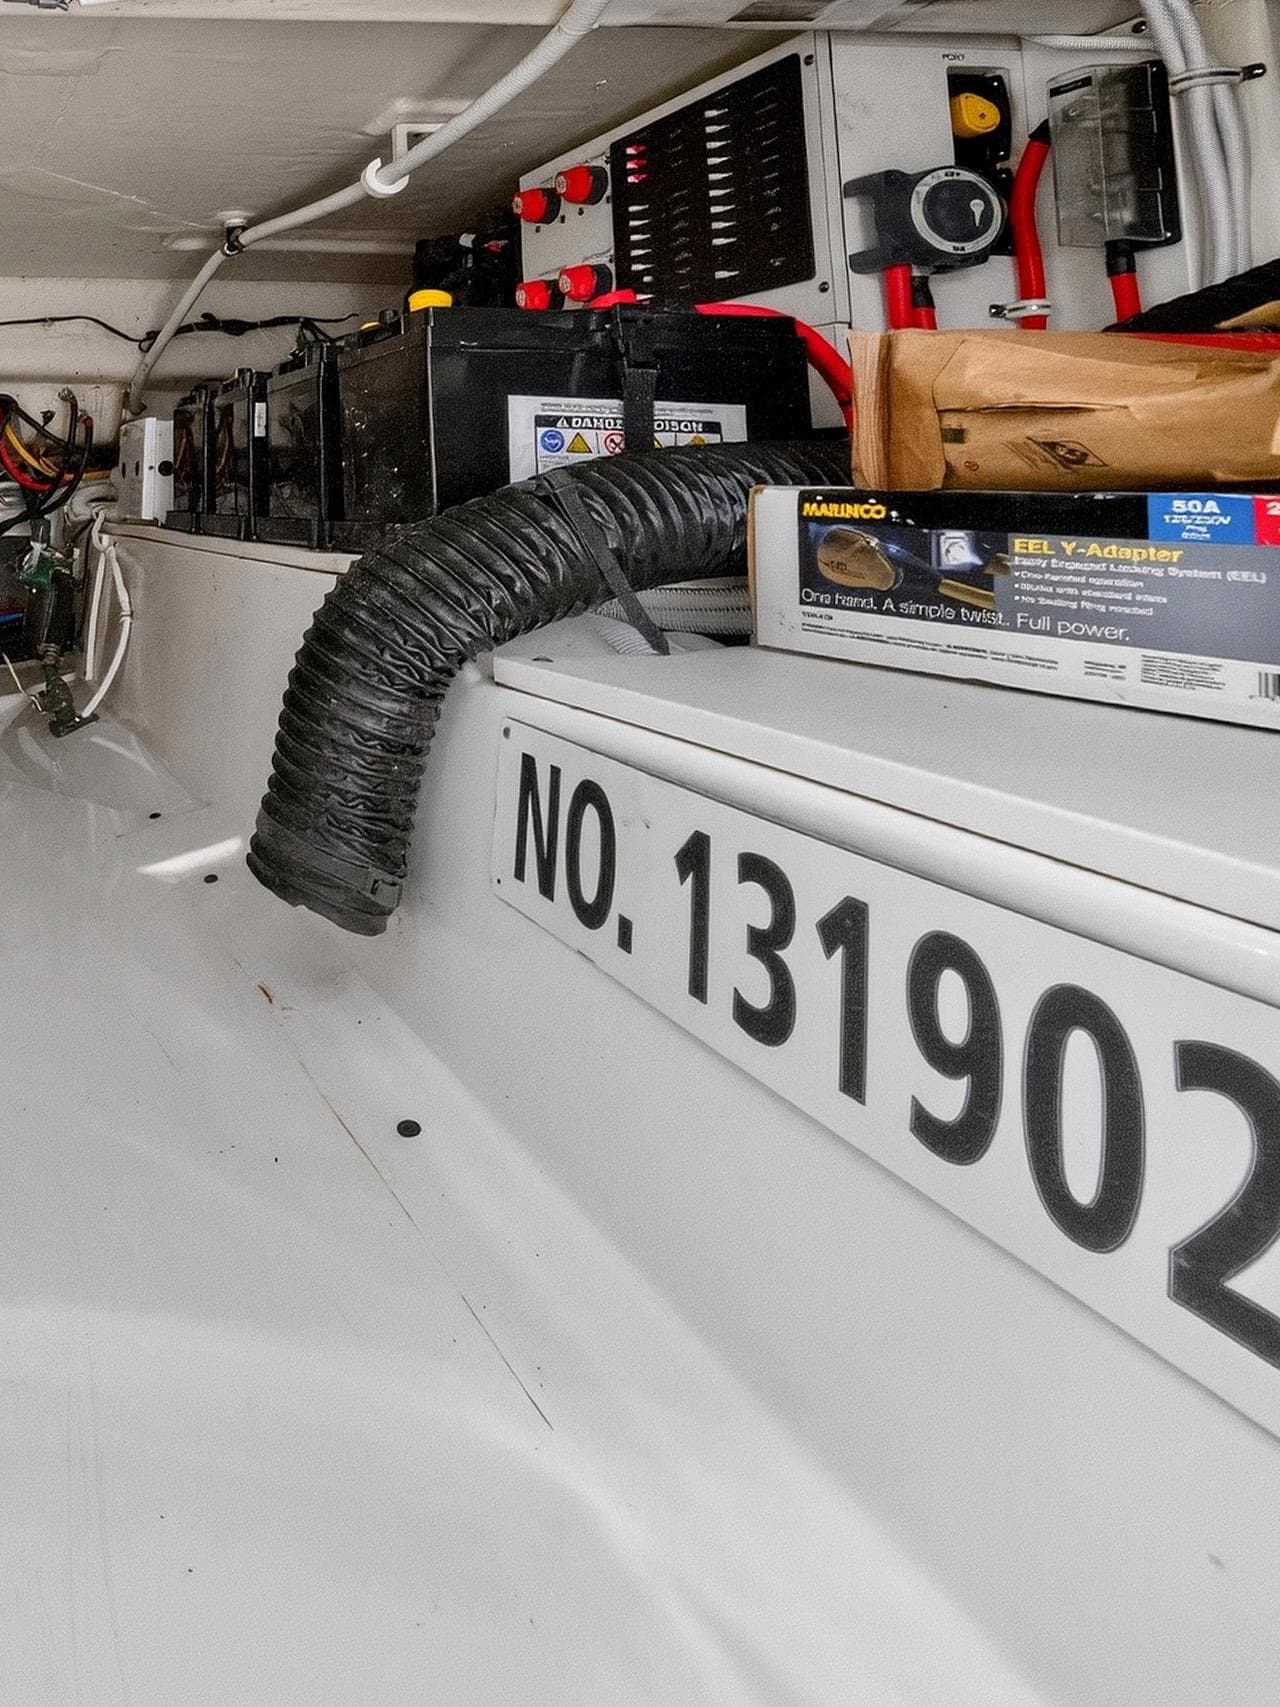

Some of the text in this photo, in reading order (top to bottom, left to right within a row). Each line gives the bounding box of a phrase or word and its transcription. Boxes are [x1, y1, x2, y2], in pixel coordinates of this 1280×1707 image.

[654, 420, 703, 433] OISON
[1172, 500, 1221, 514] 50A
[1013, 538, 1184, 563] EEL Y-Adapter
[1168, 566, 1222, 580] System
[1226, 569, 1267, 584] (EEL)
[801, 588, 1131, 641] One hand. A simple twist. Full power.
[514, 752, 1280, 1370] NO. 131902
